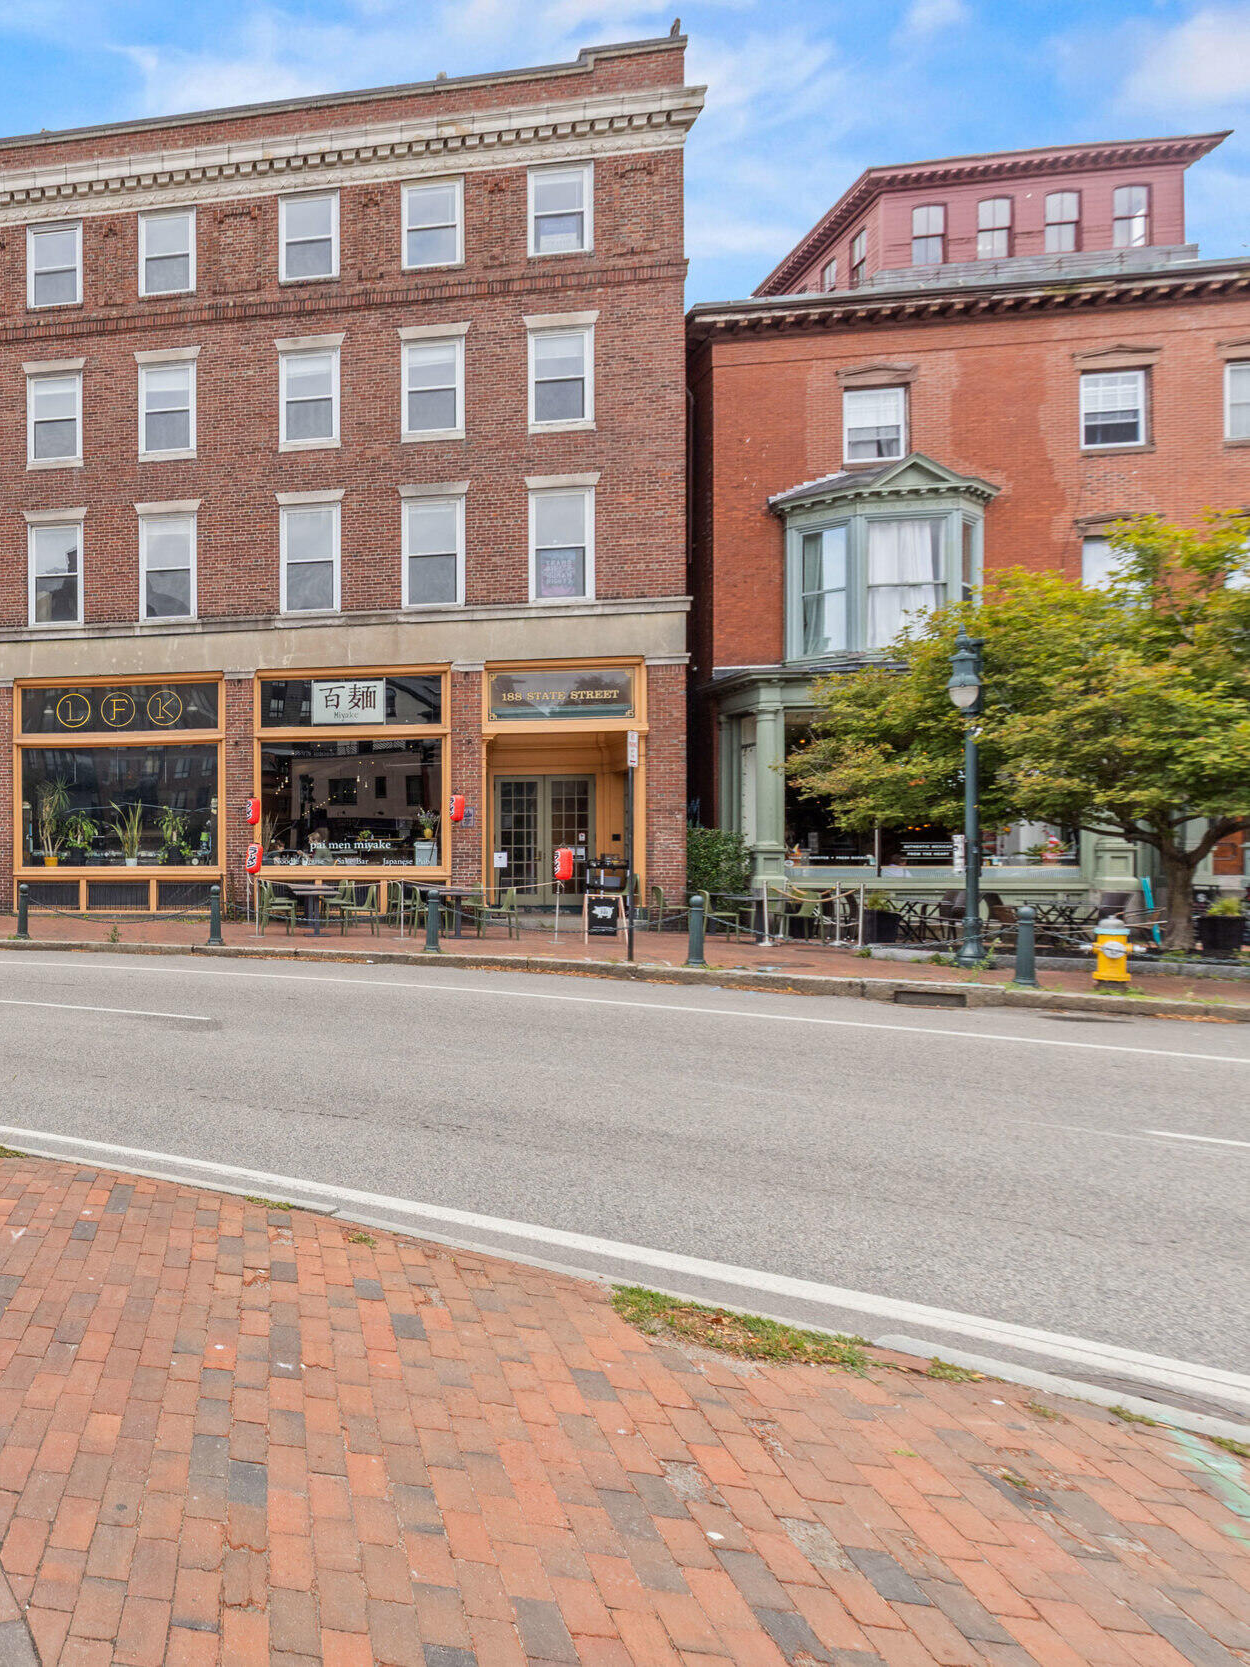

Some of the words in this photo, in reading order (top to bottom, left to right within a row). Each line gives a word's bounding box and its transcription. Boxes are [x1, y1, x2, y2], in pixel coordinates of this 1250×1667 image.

[501, 692, 523, 702] 188
[526, 690, 567, 701] STATE
[570, 689, 620, 700] STREET
[334, 711, 359, 722] Miyake
[310, 840, 326, 852] pai
[353, 840, 391, 852] miyake
[356, 857, 369, 865] Bar
[382, 857, 413, 867] Japanese
[416, 857, 431, 865] Pub
